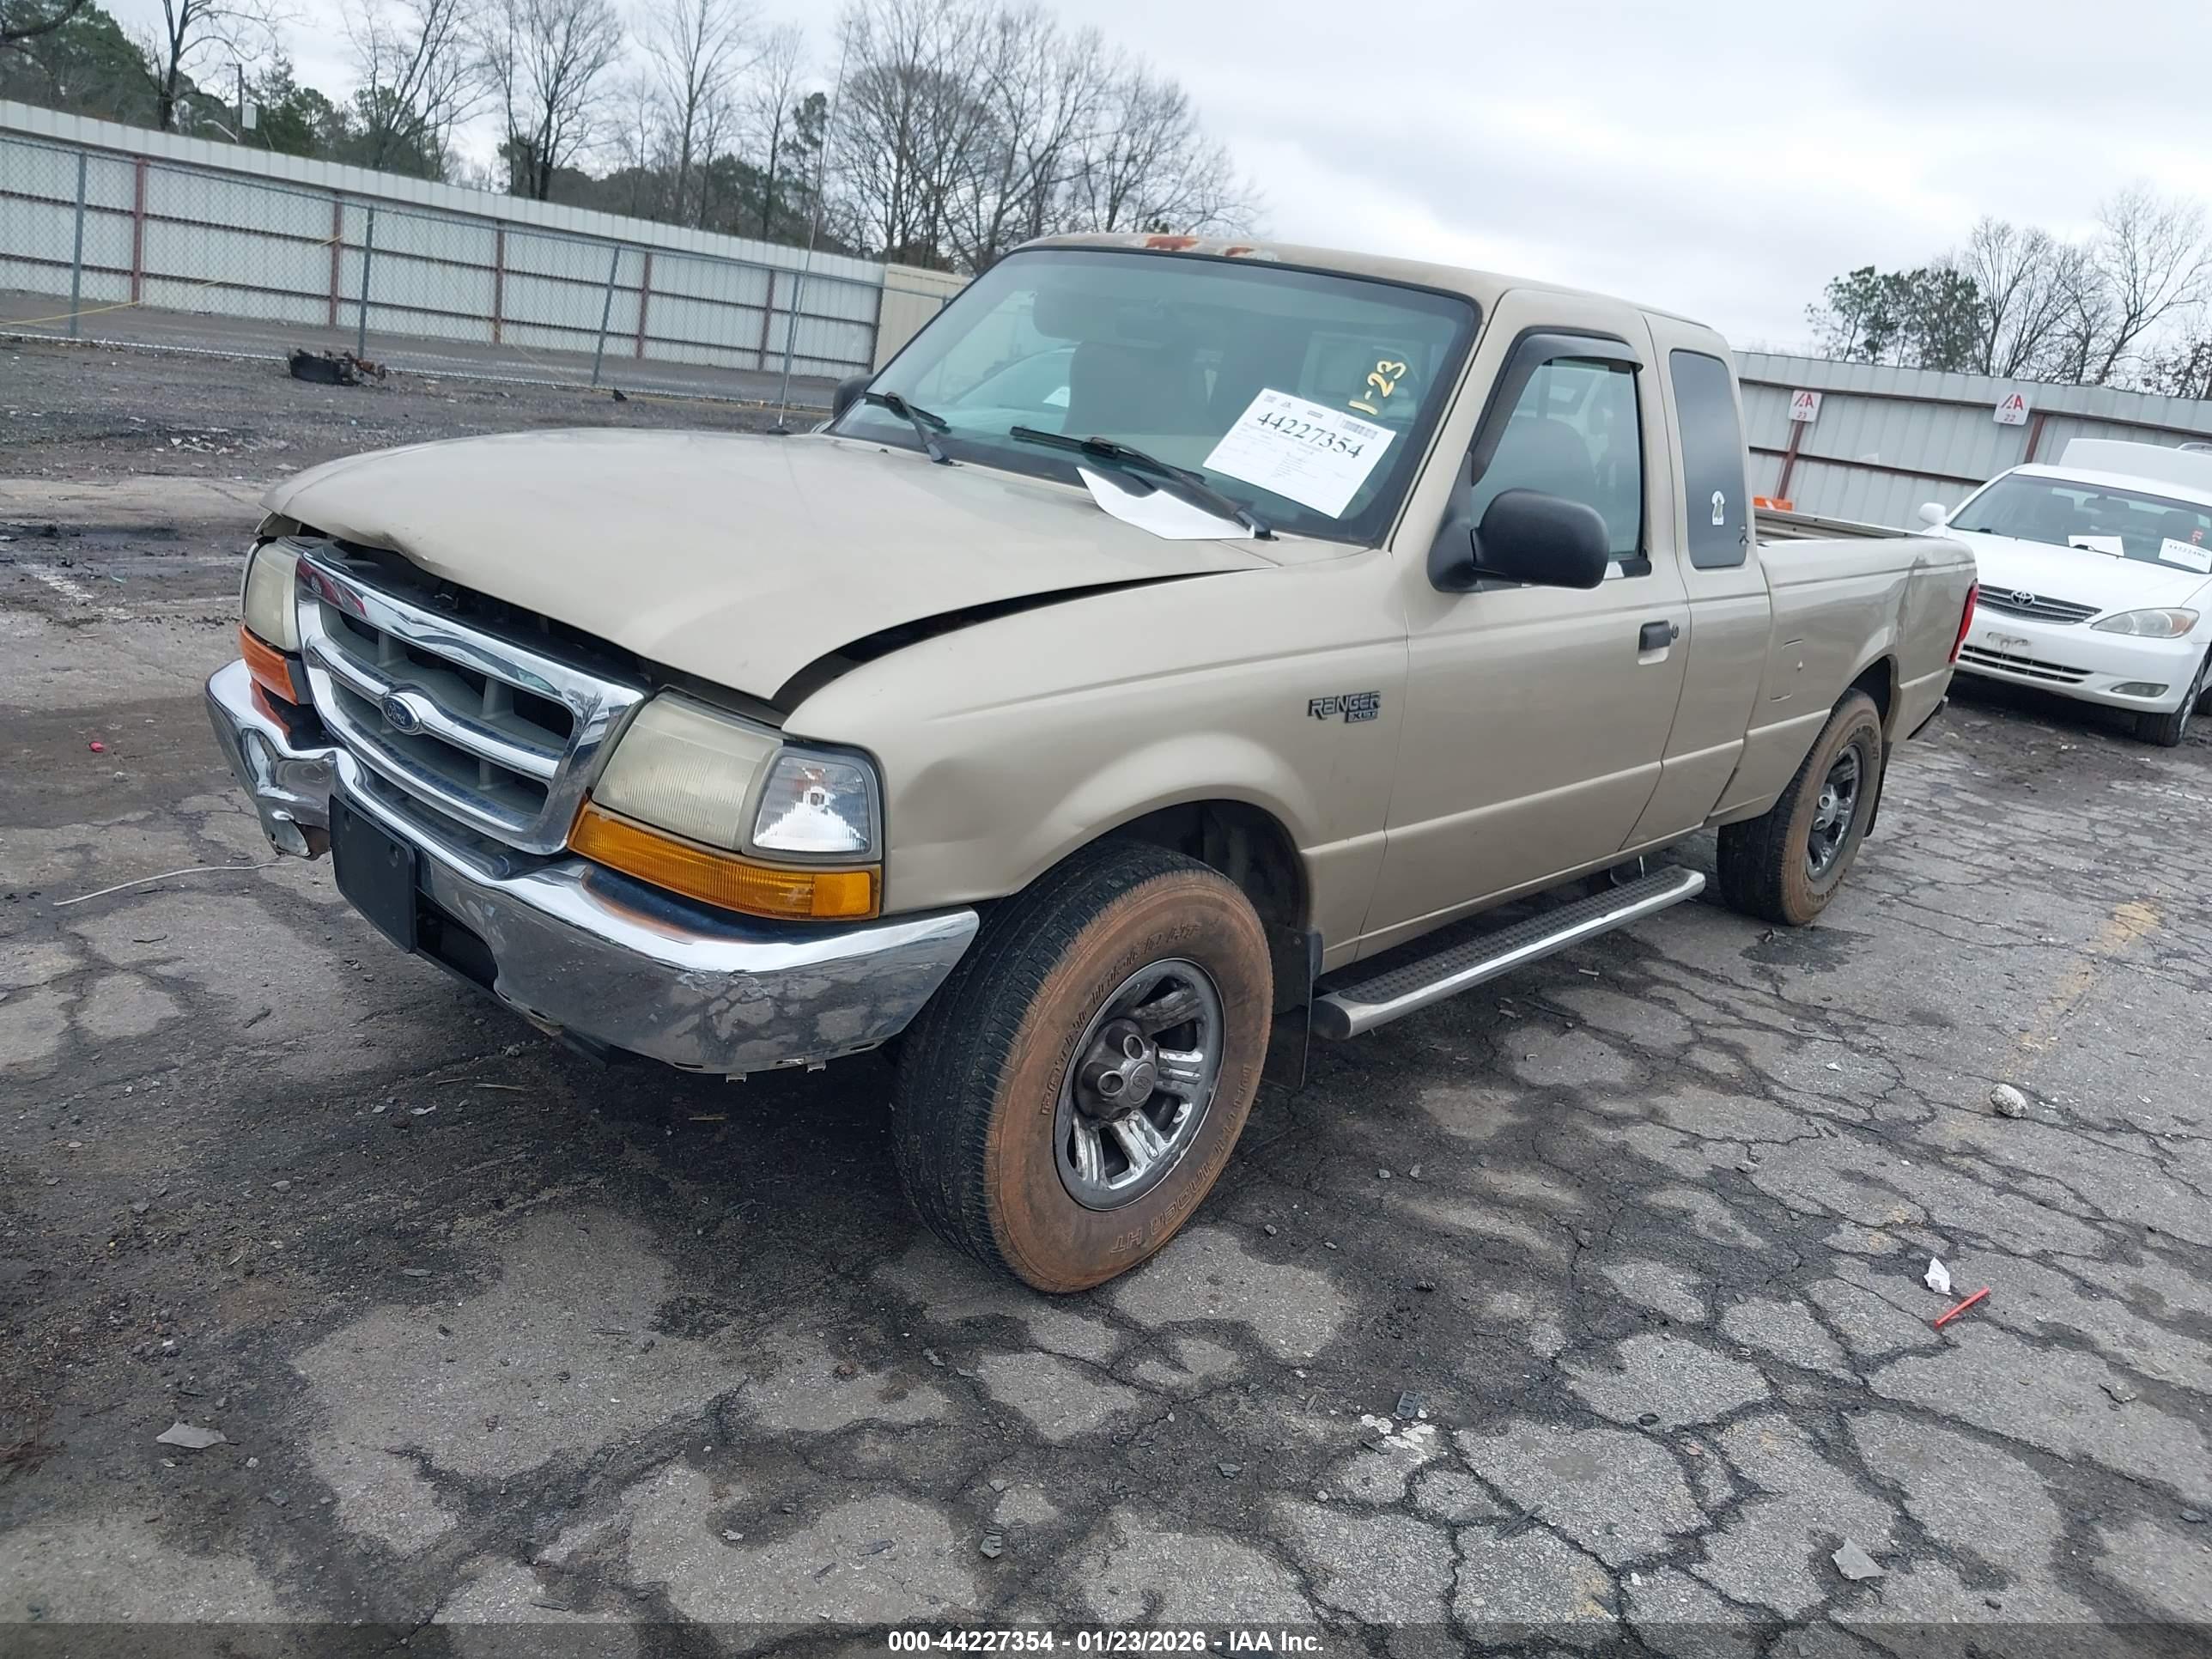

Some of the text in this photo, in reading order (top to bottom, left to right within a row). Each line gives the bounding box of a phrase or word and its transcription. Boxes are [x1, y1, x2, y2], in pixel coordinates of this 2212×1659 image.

[1348, 361, 1407, 416] 1-23
[1257, 411, 1364, 459] 44227354
[387, 702, 406, 726] Ford
[1307, 690, 1381, 720] RANGER
[1352, 711, 1376, 721] XLT
